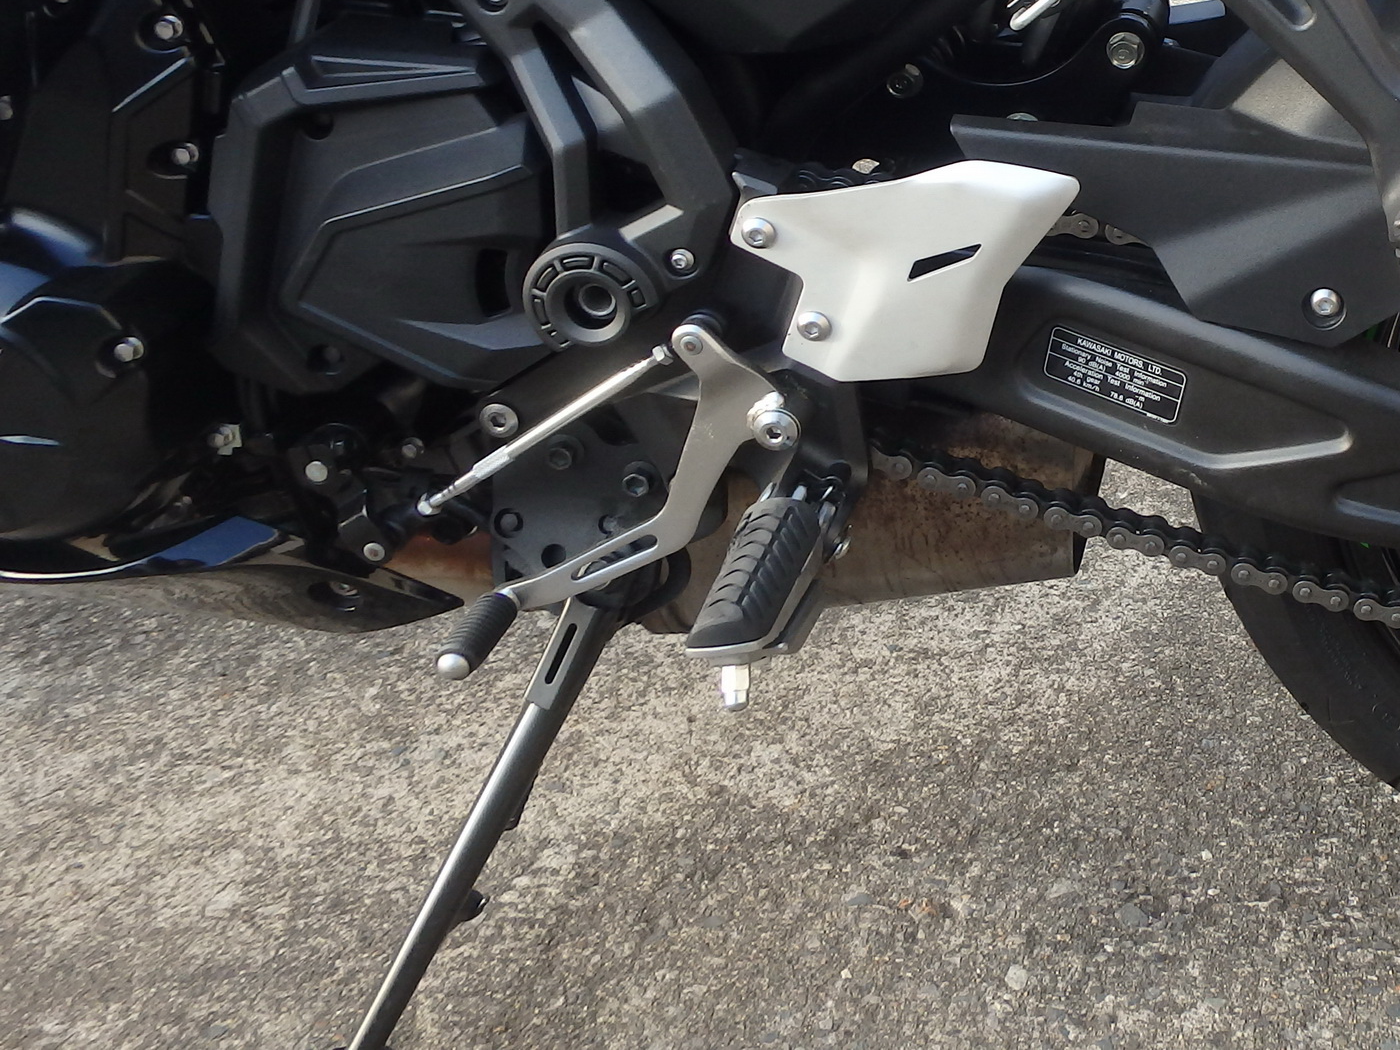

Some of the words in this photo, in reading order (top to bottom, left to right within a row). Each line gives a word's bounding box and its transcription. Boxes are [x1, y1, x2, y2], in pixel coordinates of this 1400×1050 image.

[1062, 343, 1091, 360] Stationary
[1095, 356, 1113, 367] Noise
[1116, 362, 1130, 374] Test
[1134, 371, 1167, 388] Information
[1077, 338, 1112, 356] KAWASAKI
[1148, 364, 1162, 375] LTD.
[1088, 361, 1106, 372] dB(A)
[1115, 371, 1130, 381] 4000
[1064, 360, 1103, 380] Acceleration
[1107, 375, 1121, 386] Test
[1125, 383, 1161, 401] Information
[1073, 370, 1083, 378] 4th
[1086, 376, 1101, 385] gear
[1083, 380, 1100, 392] km/h
[1125, 398, 1143, 409] dB(A)
